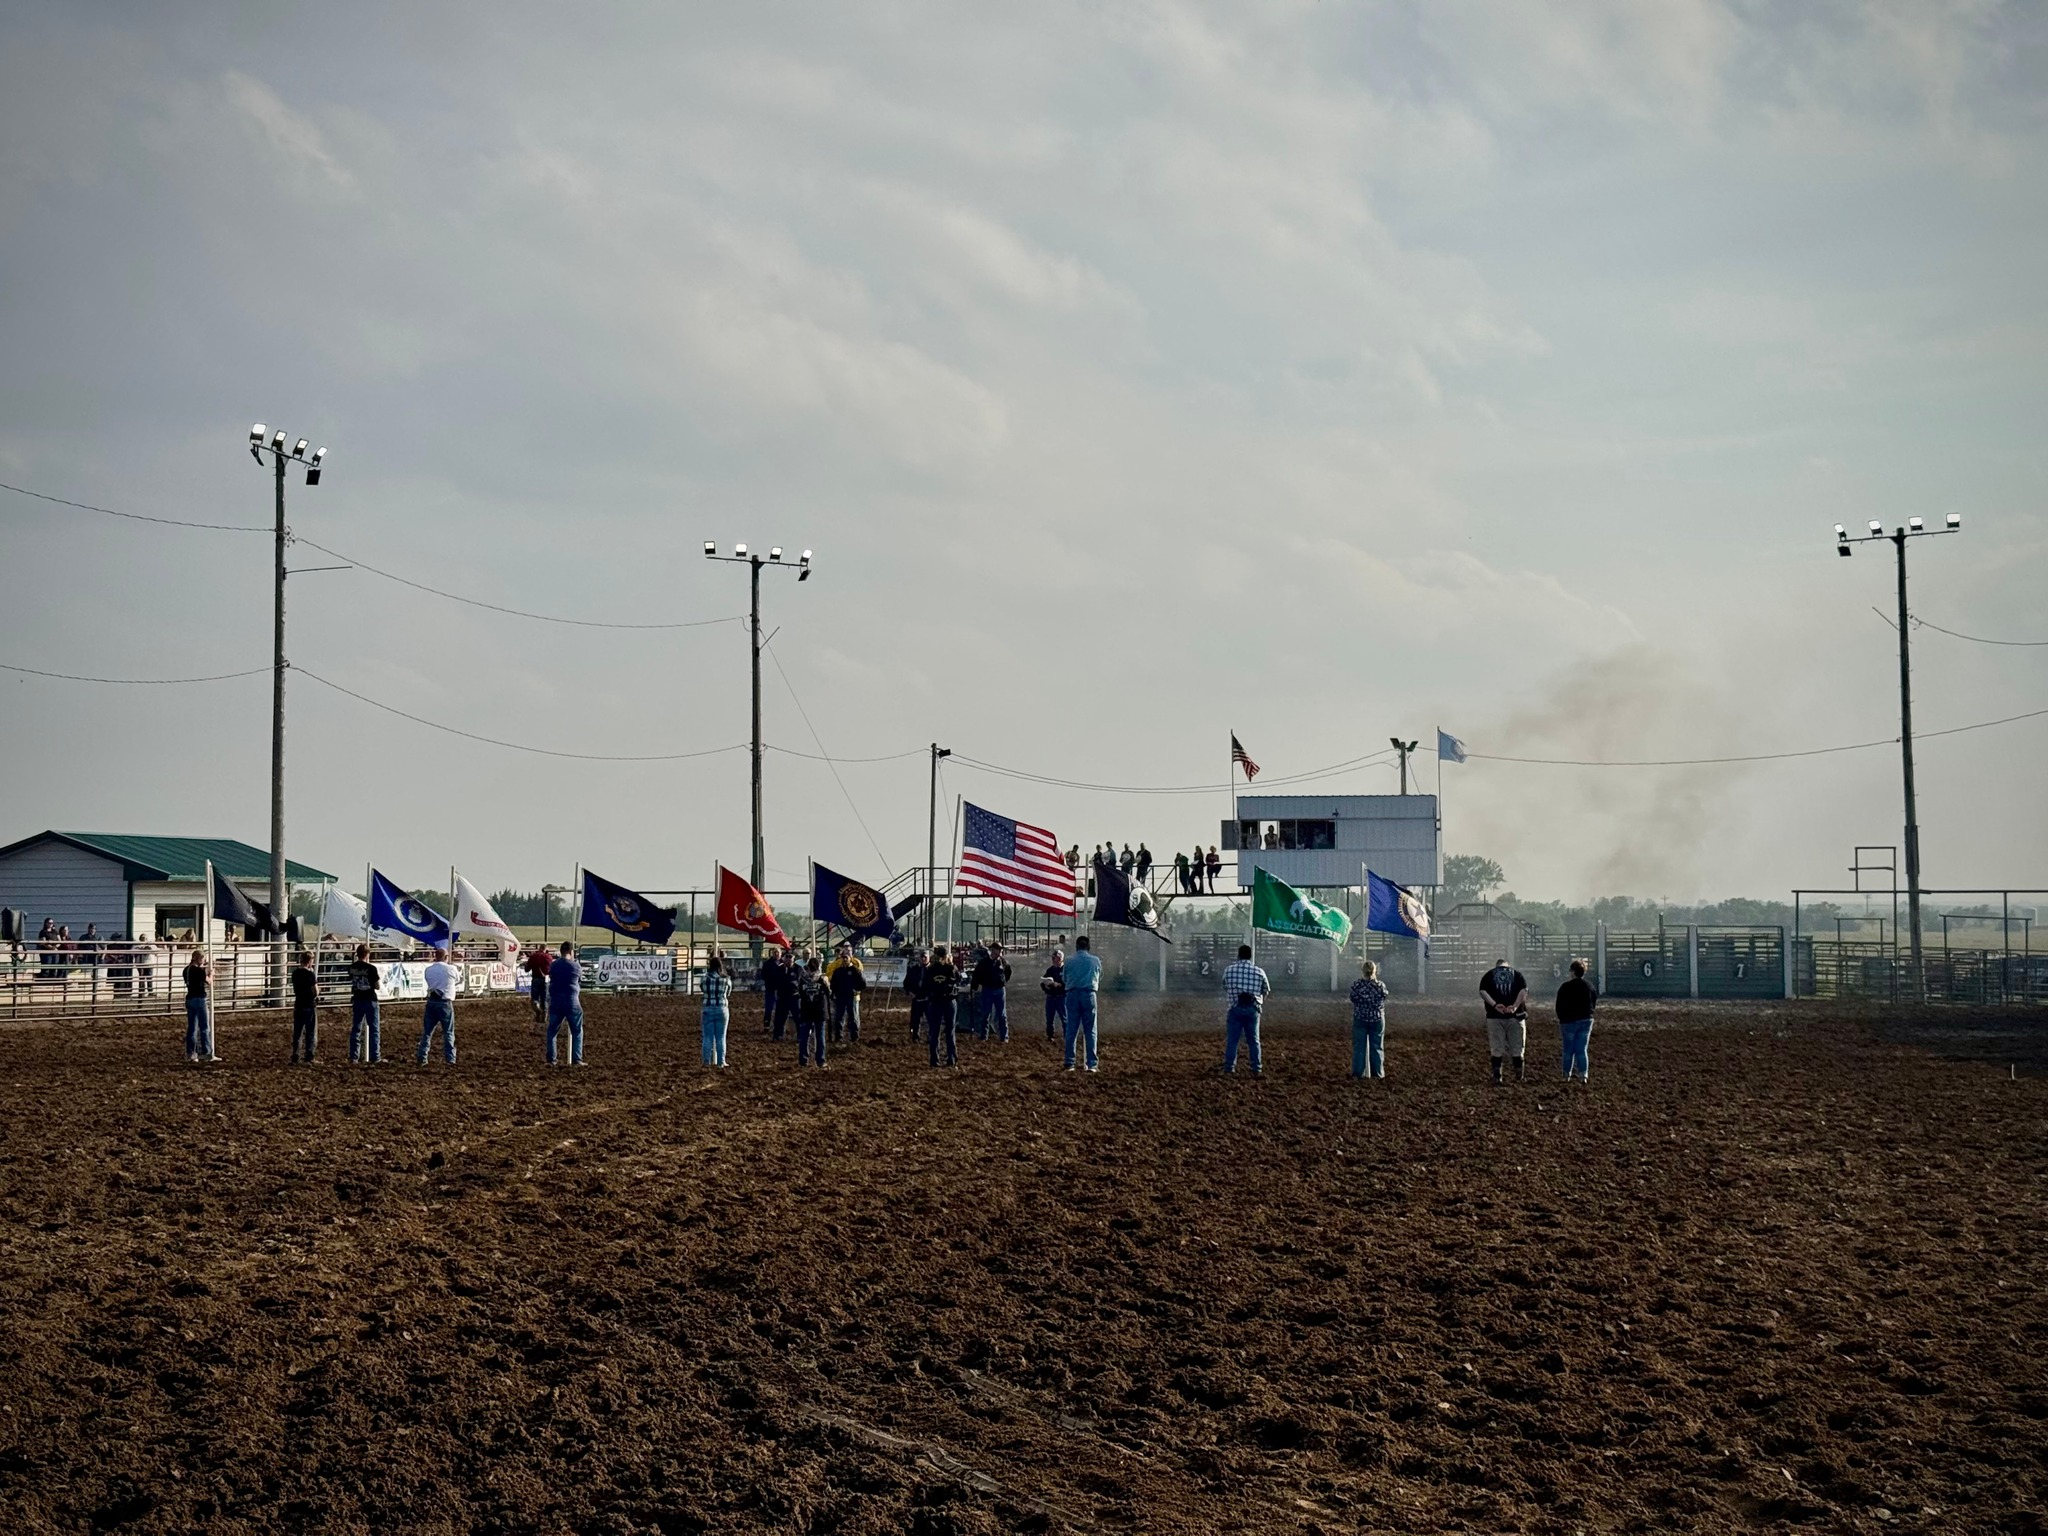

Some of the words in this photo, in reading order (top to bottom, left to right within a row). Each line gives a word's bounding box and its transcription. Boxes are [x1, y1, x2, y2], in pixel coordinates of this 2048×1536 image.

[1267, 917, 1341, 939] ASSOCIATION
[649, 960, 669, 970] OIL
[1201, 961, 1209, 975] 2
[1287, 961, 1295, 975] 3
[1553, 964, 1560, 977] 5
[1643, 963, 1652, 977] 6
[1737, 964, 1745, 978] 7
[492, 973, 512, 983] MARKET
